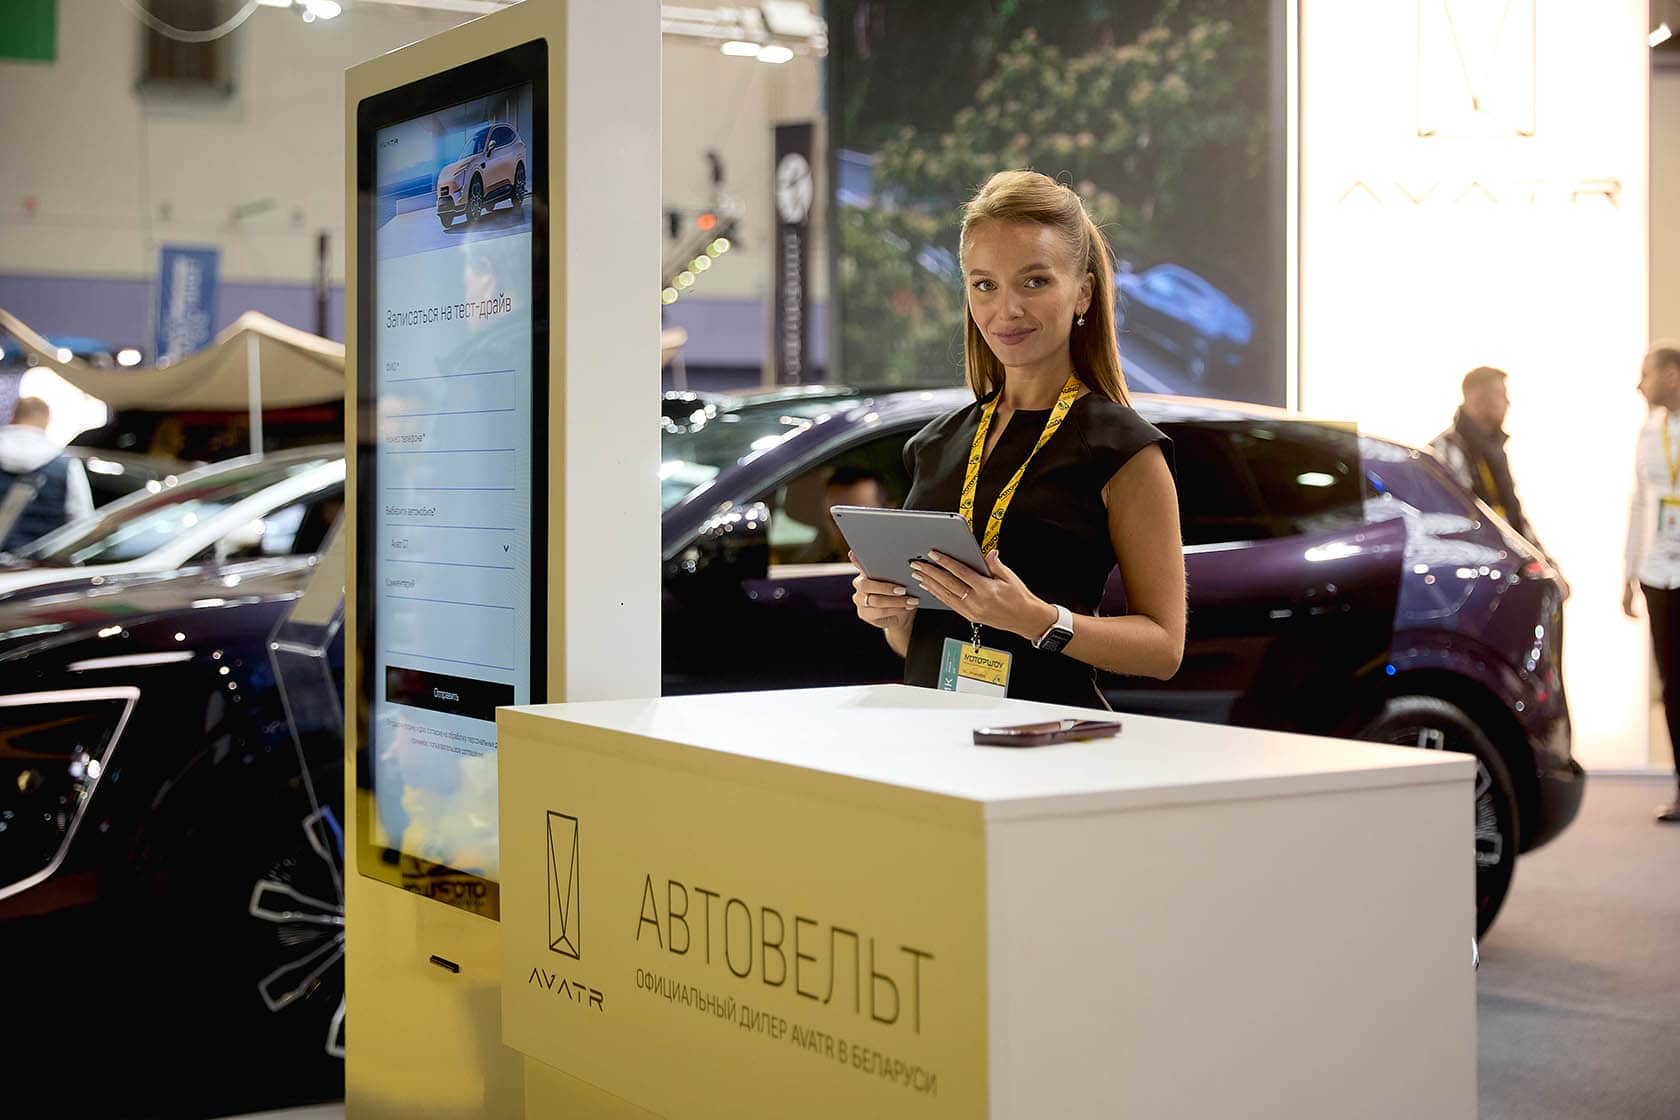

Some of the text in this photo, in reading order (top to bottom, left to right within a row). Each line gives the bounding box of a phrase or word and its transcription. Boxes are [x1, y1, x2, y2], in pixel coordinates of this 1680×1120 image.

[386, 292, 511, 328] Записаться на тест-драйв
[528, 967, 604, 1011] AVATR
[636, 873, 935, 1034] АВТОВЕЛЬТ
[636, 967, 938, 1098] ОФИЦИАЛЬНЫЙ ДИЛЕР AVATR В БЕЛАРУСИ
